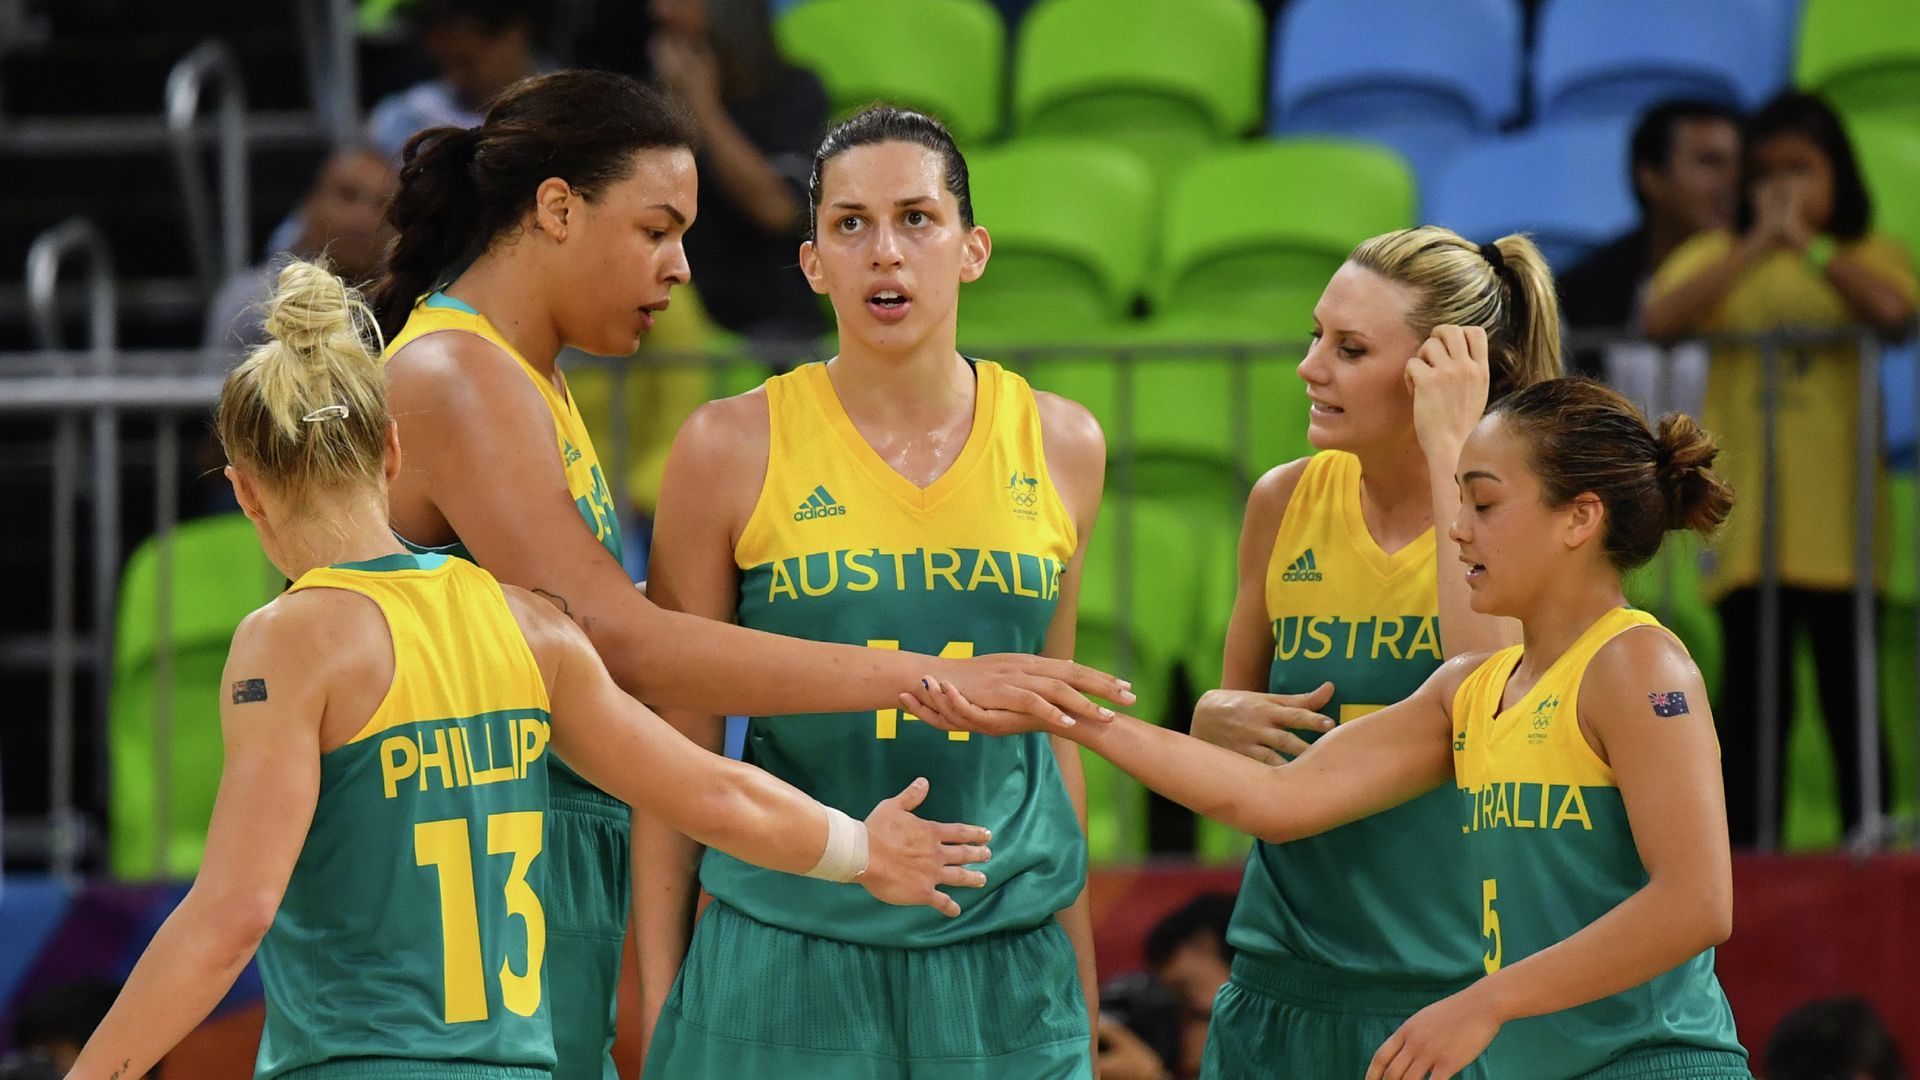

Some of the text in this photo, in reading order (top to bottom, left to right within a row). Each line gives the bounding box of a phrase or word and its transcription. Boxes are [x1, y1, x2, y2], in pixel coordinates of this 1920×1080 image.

[793, 503, 846, 522] adidas
[768, 547, 1060, 603] AUSTRALIA
[1281, 570, 1323, 583] adidas
[1272, 616, 1443, 661] USTRA
[1462, 783, 1594, 834] TRALIA
[414, 811, 547, 1025] 13
[1482, 878, 1502, 977] 5
